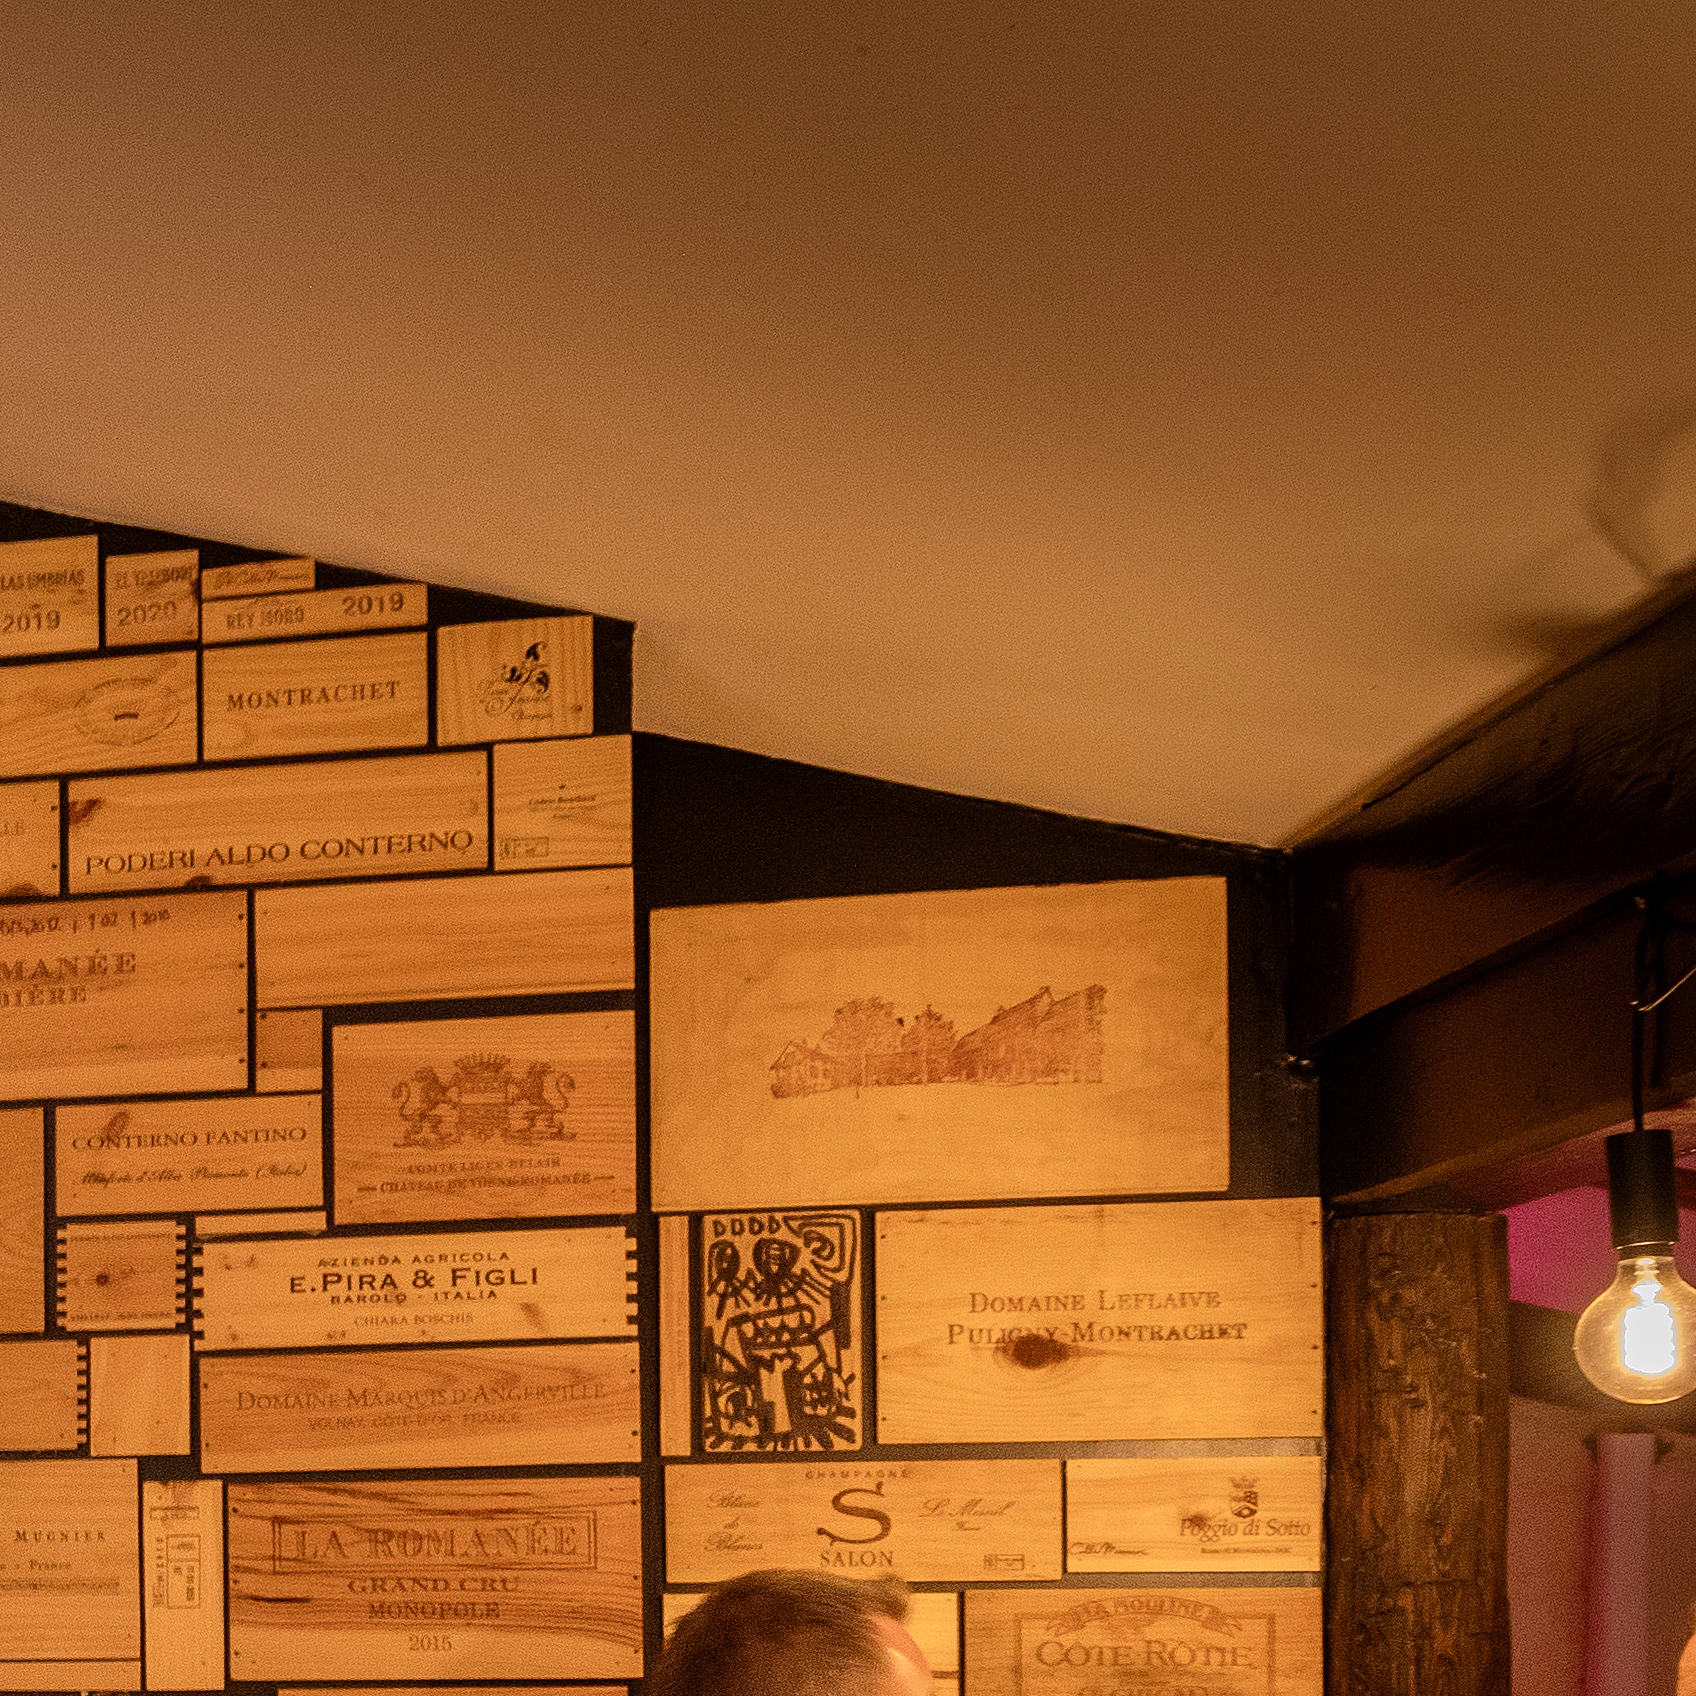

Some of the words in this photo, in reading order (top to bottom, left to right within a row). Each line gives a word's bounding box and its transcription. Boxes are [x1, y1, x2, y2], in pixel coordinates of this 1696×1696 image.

[117, 601, 178, 627] 2020
[343, 592, 405, 617] 2019
[3, 610, 61, 634] 2019
[226, 679, 401, 712] MONTRACHET
[85, 848, 197, 876] PODERI
[203, 839, 292, 869] ALDO
[298, 829, 475, 863] CONTERNO
[71, 1130, 199, 1151] CONTERNO
[205, 1125, 308, 1147] FANTINO
[317, 1254, 403, 1269] AZIENDA
[411, 1251, 511, 1265] AGRICOLA
[411, 1268, 437, 1290] &
[450, 1267, 539, 1288] FIGLI
[330, 1292, 408, 1307] BAROLO
[432, 1289, 499, 1302] ITALIA
[968, 1291, 1086, 1315] DOMAINE
[1097, 1288, 1223, 1312] LEFLAIVE
[946, 1319, 1249, 1350] PULIGNY-MONTRACHET
[235, 1391, 342, 1413] DOMAINE
[345, 1387, 449, 1410] MARQUIS
[804, 1469, 910, 1480] CHAMPAGNE
[14, 1528, 108, 1545] MUGNIER
[292, 1527, 350, 1562] LA
[366, 1517, 578, 1562] ROMANÉE
[1178, 1518, 1239, 1544] Poggio
[1241, 1517, 1260, 1537] di
[1265, 1518, 1312, 1537] Sotto
[819, 1550, 895, 1568] SALON
[347, 1576, 452, 1595] GRAND
[459, 1575, 522, 1594] CRU
[367, 1601, 502, 1621] MONOPOLE
[407, 1634, 454, 1653] 2015
